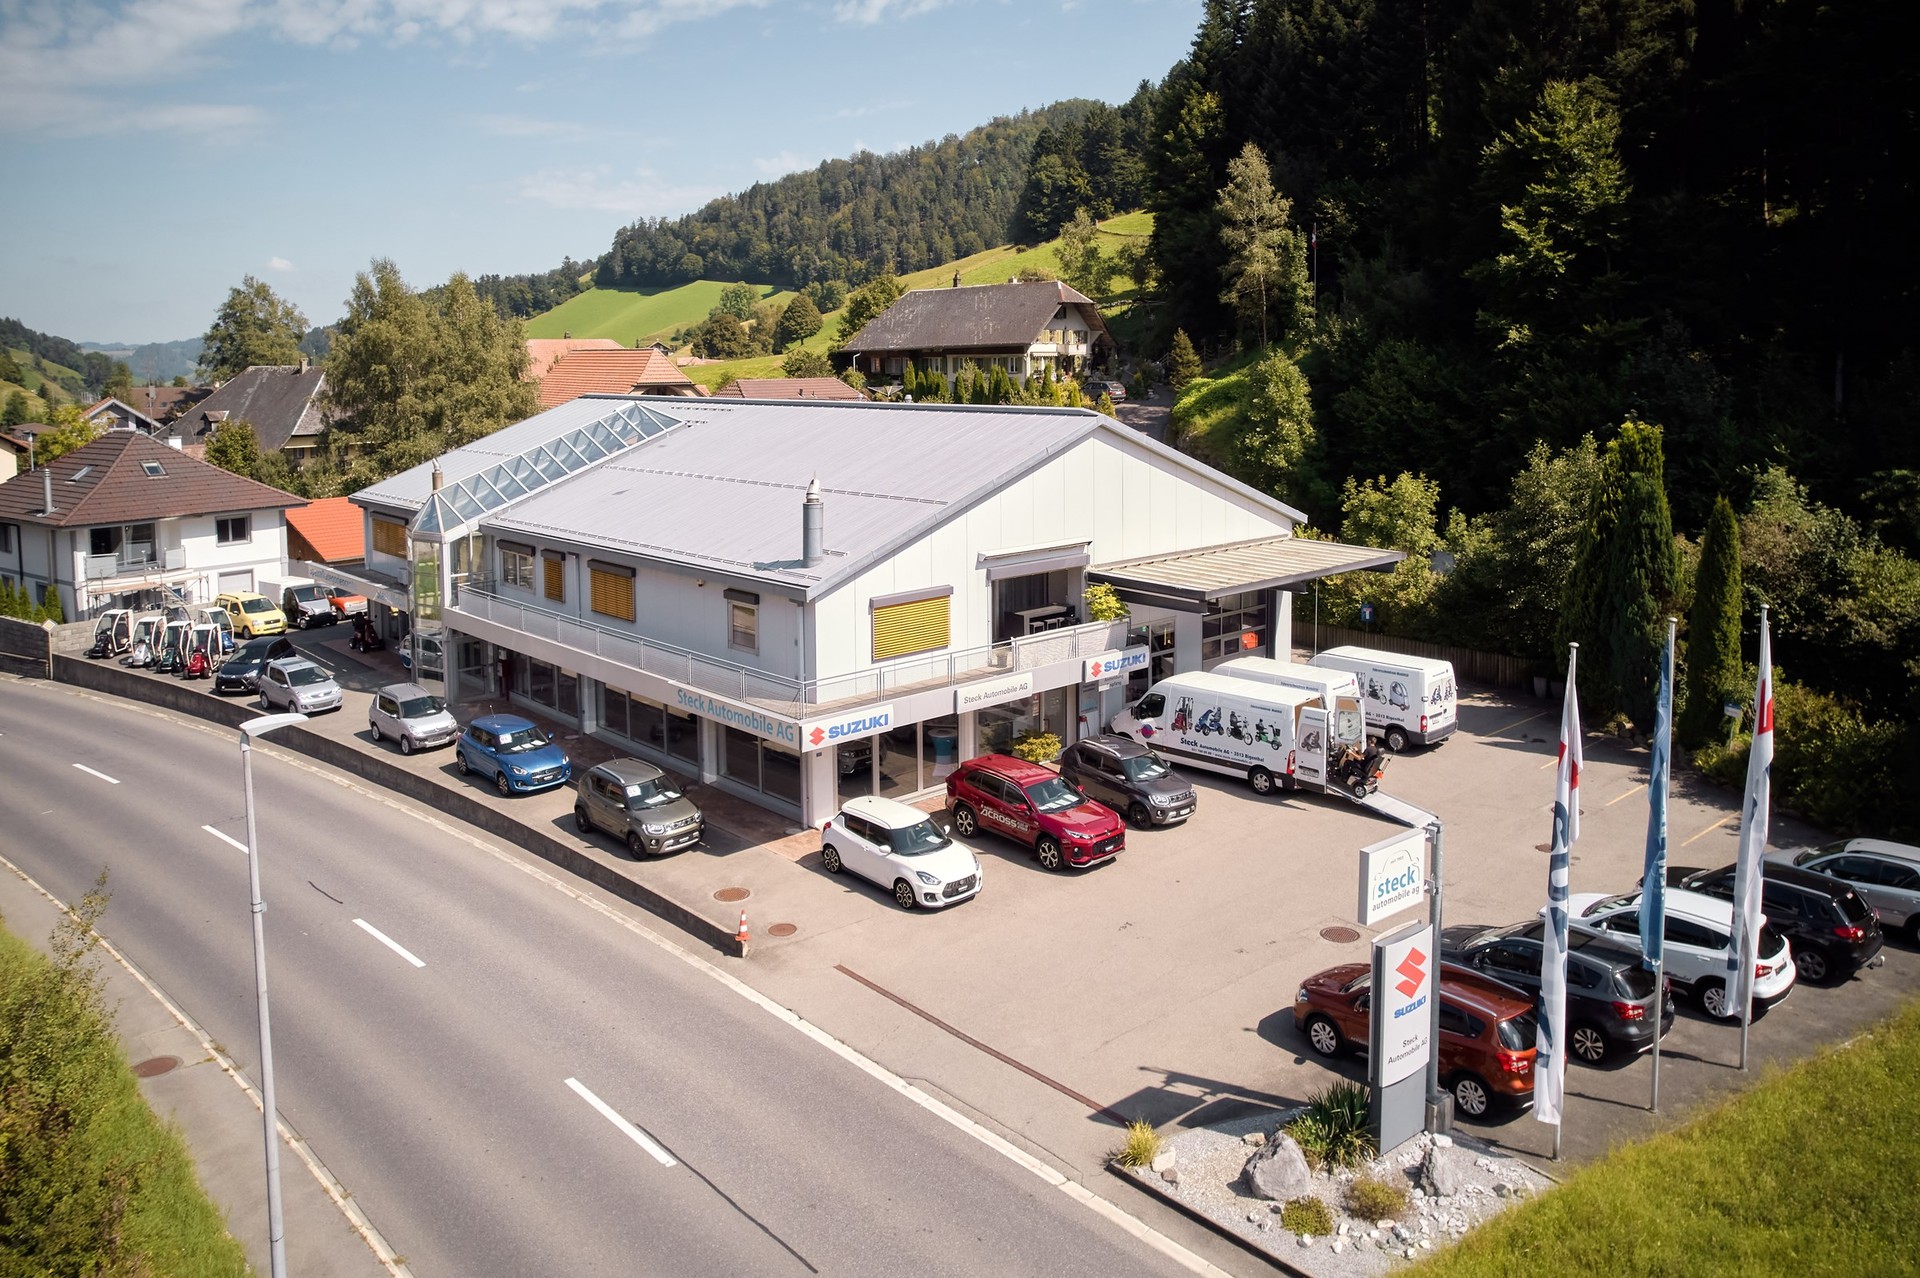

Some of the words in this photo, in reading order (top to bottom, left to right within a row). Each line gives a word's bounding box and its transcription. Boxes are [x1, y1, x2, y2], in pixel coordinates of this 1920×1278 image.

[1103, 652, 1146, 673] SUZUKI
[963, 693, 982, 705] Steck
[983, 685, 1018, 700] Automobile
[1018, 682, 1028, 691] AG
[677, 689, 706, 712] Steck
[707, 699, 774, 735] Automobile
[776, 722, 795, 742] AG
[827, 713, 889, 740] SUZUKI
[1180, 737, 1198, 748] Steck
[1199, 743, 1223, 753] Automobile
[980, 808, 1017, 828] ACROSS
[1377, 866, 1415, 899] steck
[1372, 888, 1411, 912] automobile
[1411, 885, 1420, 895] ag
[1393, 995, 1426, 1019] SUZUKI
[1387, 1043, 1420, 1065] Automobile
[1421, 1036, 1428, 1047] AG
[1402, 1033, 1419, 1048] Steck
